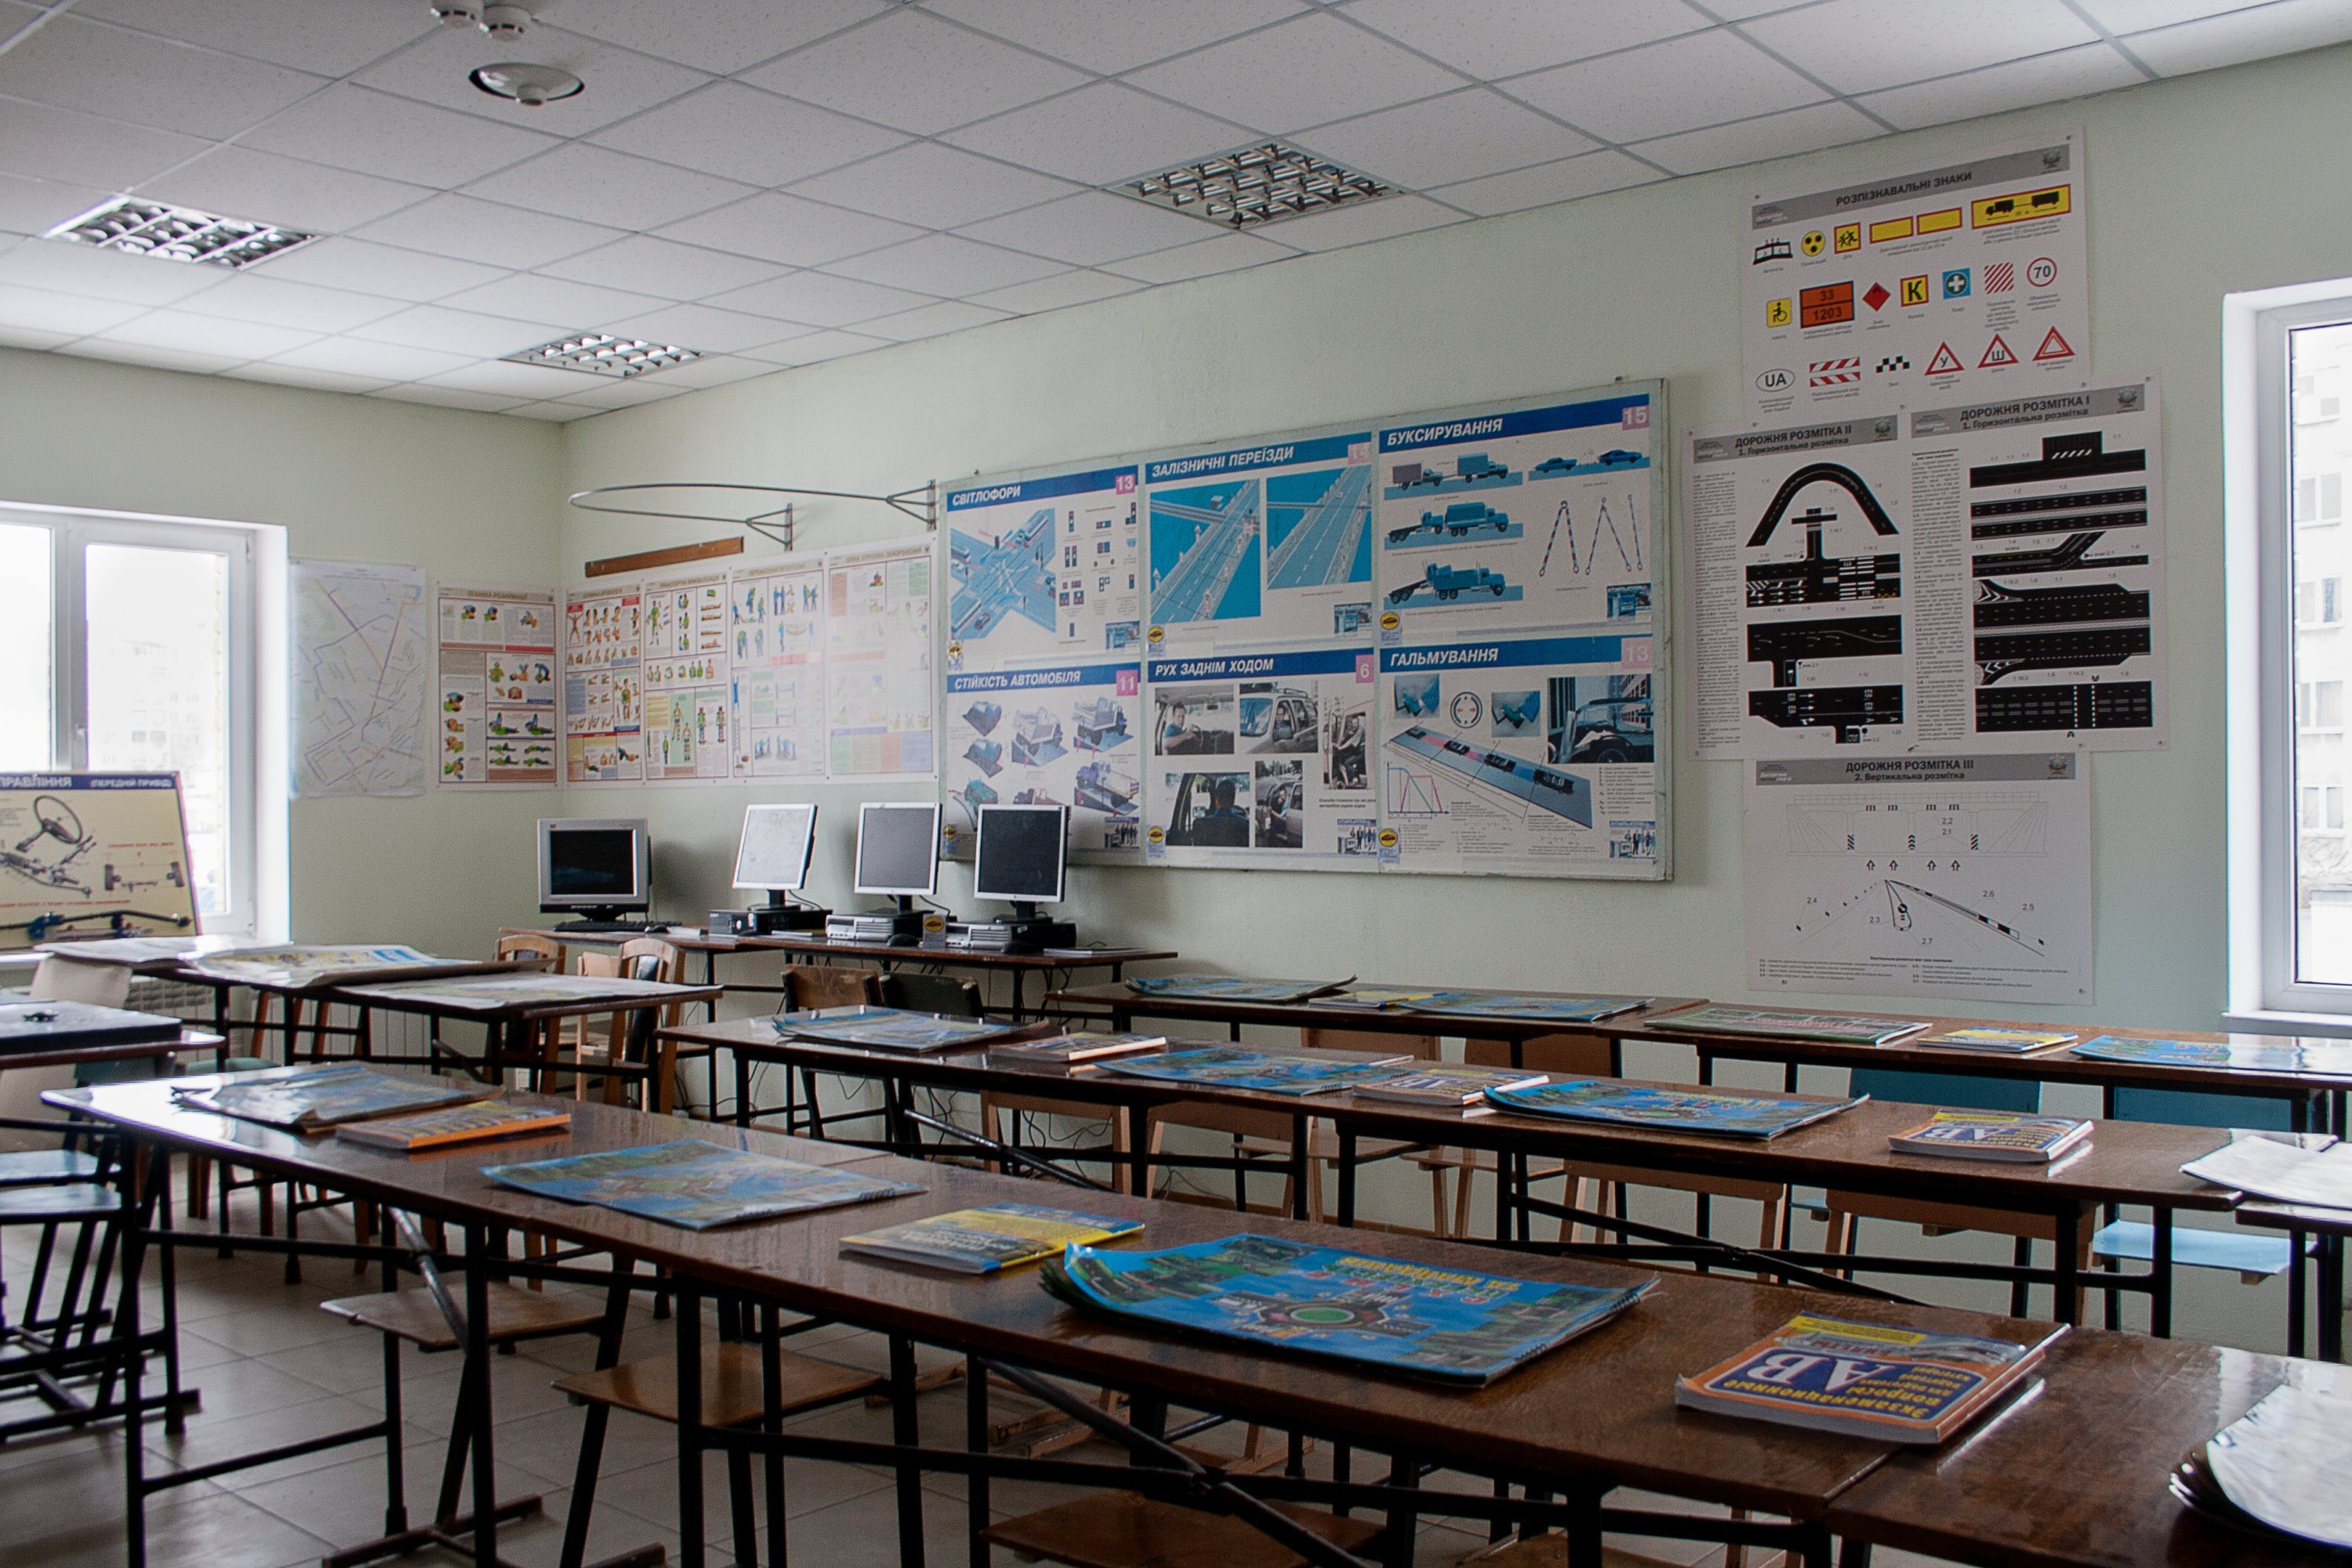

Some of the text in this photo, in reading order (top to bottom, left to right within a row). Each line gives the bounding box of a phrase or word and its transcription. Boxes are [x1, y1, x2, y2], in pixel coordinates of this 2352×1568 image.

[1835, 171, 1973, 207] РОЗПІЗНАВАЛЬНІ ЗНАКИ
[2034, 265, 2051, 278] 70
[1820, 289, 1835, 302] 33
[1907, 279, 1924, 303] К
[1813, 307, 1842, 321] 1203
[1991, 349, 2005, 361] Ш
[1765, 372, 1788, 388] UA
[1624, 406, 1647, 426] 15
[1960, 403, 2020, 422] ДОРОЖНЯ
[2023, 396, 2083, 412] РОЗМІТКА
[1973, 413, 2042, 430] Горизонтальна
[2044, 408, 2089, 423] розмітка
[1387, 417, 1504, 447] БУКСИРУВАННЯ
[1735, 432, 1788, 449] ДОРОЖНЯ
[1790, 426, 1842, 441] РОЗМІТКА
[1748, 441, 1809, 456] Горизонтальна
[1810, 436, 1849, 452] розмітка
[1152, 446, 1294, 477] ЗАЛІЗНИЧНІ ПЕРЕЇЗДИ
[1116, 475, 1134, 492] 13
[953, 485, 1021, 506] СВІТЛОФОРИ
[1389, 648, 1499, 667] ГАЛЬМУВАННЯ
[1625, 644, 1649, 661] 13
[1155, 658, 1274, 677] РУХ ЗАДНІМ ХОДОМ
[1360, 663, 1370, 679] 6
[955, 670, 1081, 690] СТІЙКІСТЬ АВТОМОБІЛЯ
[1120, 676, 1134, 691] 11
[1846, 760, 1901, 774] ДОРОЖНЯ
[1904, 760, 1961, 771] РОЗМІТКА
[1865, 772, 1922, 782] Вертикальна
[1923, 771, 1965, 782] розмітка
[1722, 1378, 1929, 1418] Экзаменационные
[1846, 1385, 1942, 1406] вопросы
